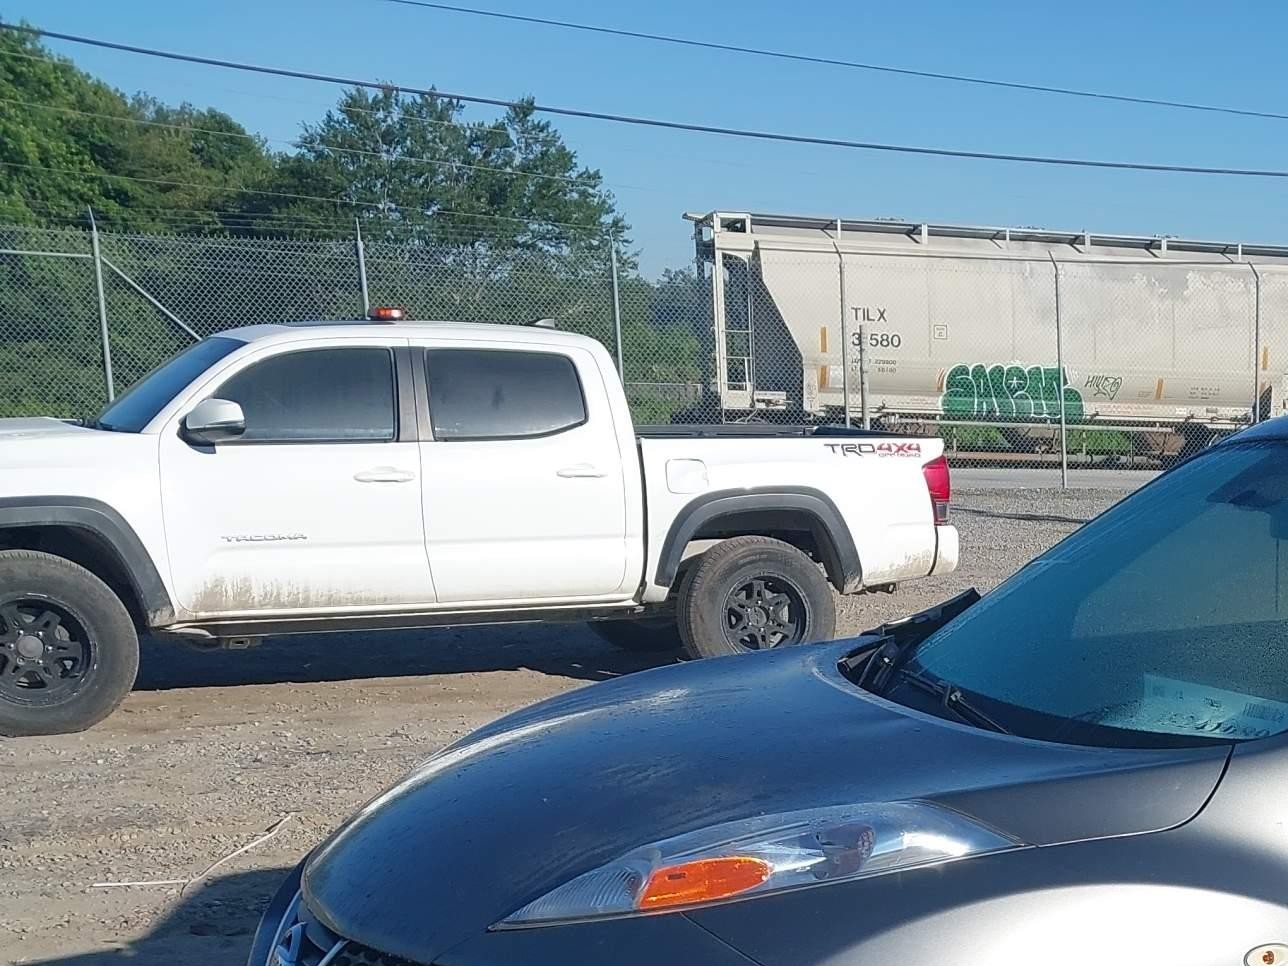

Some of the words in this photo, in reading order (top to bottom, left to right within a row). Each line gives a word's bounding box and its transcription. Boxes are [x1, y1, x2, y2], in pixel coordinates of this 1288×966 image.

[851, 307, 888, 322] TILX
[851, 332, 902, 349] 3580
[824, 443, 876, 457] TRD
